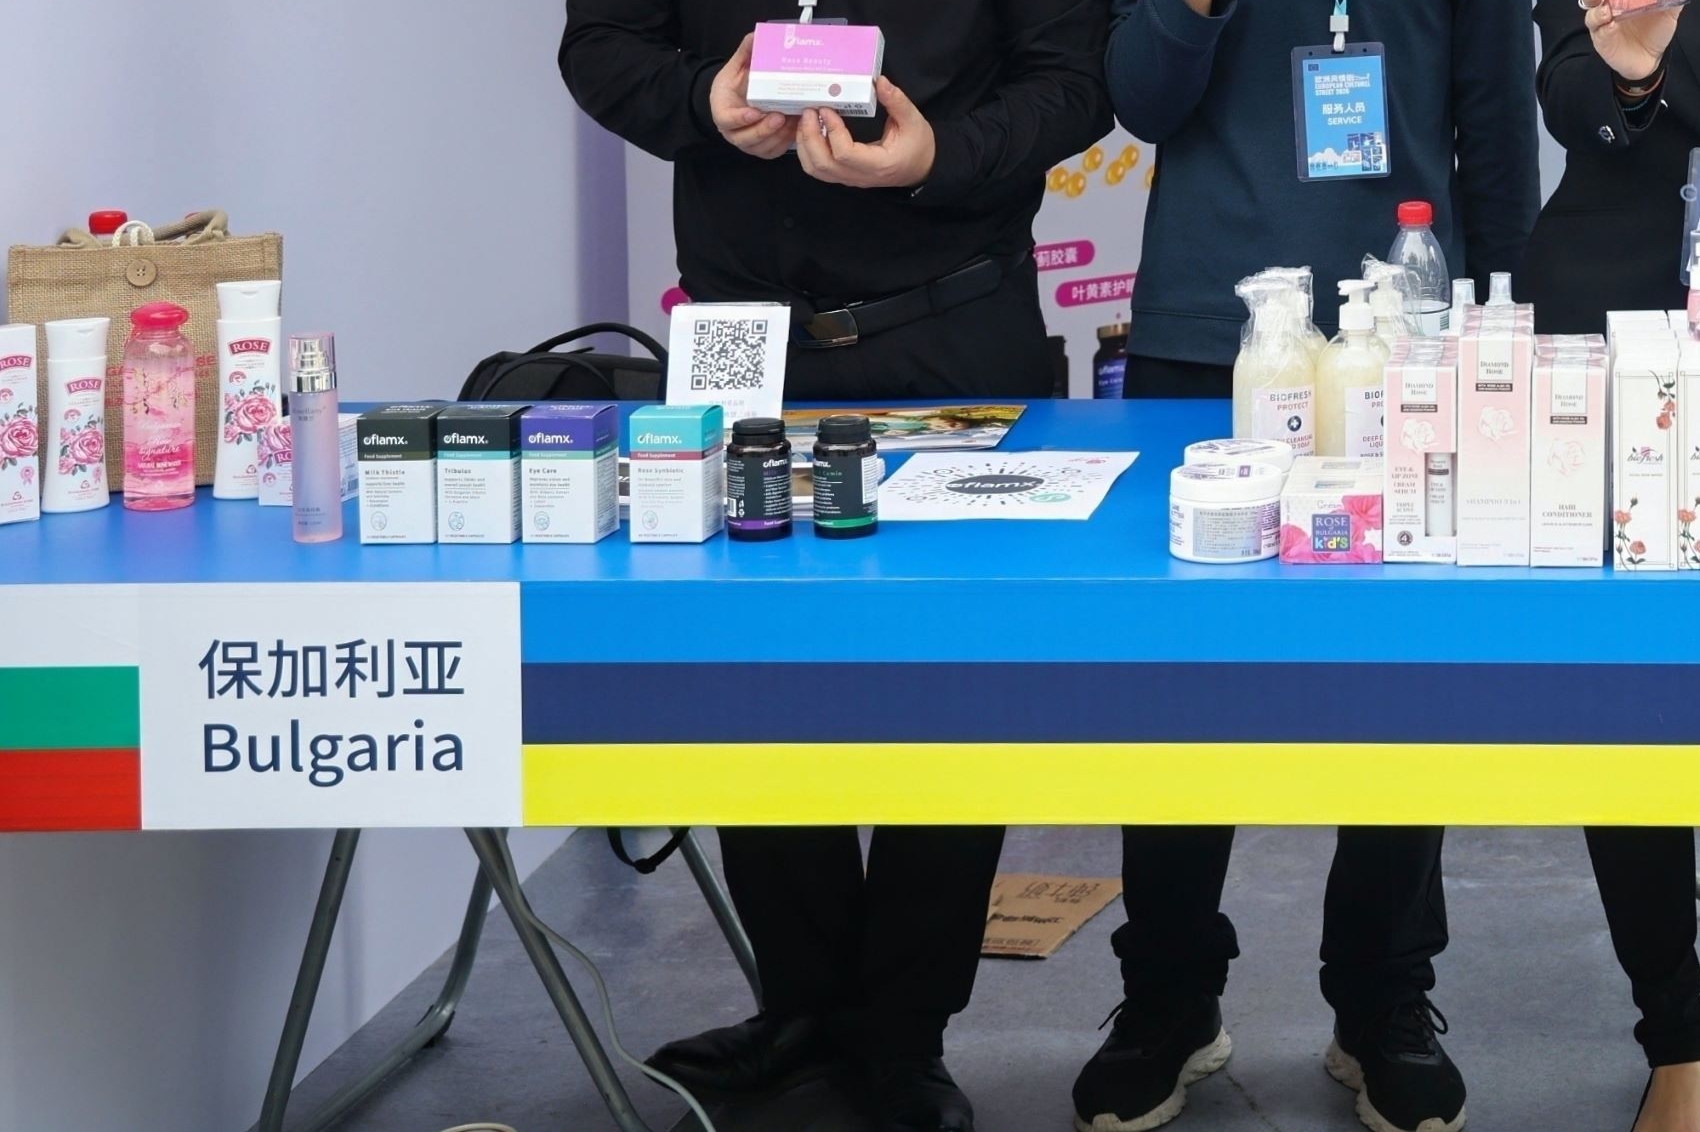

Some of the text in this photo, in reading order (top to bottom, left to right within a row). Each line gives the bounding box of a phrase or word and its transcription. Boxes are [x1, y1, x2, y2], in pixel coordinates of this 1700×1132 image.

[1322, 102, 1366, 115] 服务人员
[1328, 116, 1363, 125] SERVICE
[232, 340, 269, 353] ROSE
[1277, 402, 1309, 411] PROTECT
[1542, 510, 1592, 518] CONDITIONER
[1315, 517, 1348, 527] ROSE
[198, 639, 464, 699] 保加利亚
[203, 719, 463, 787] Bulgaria
